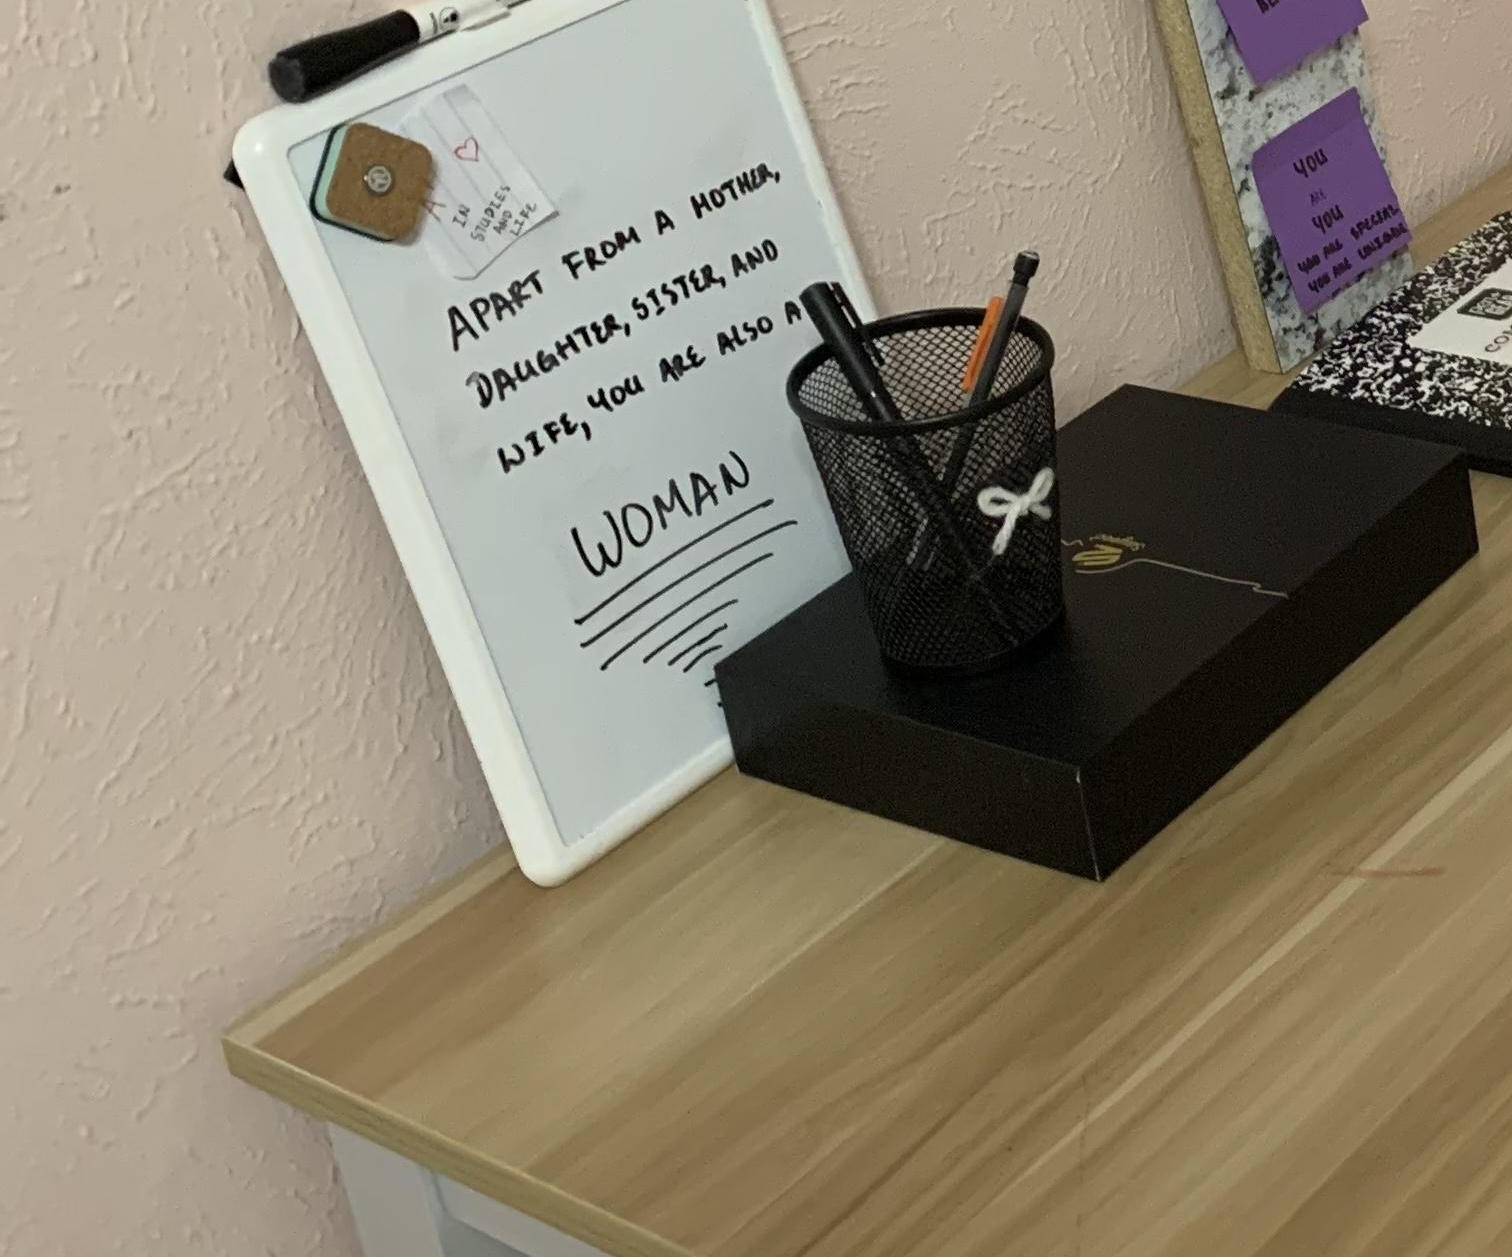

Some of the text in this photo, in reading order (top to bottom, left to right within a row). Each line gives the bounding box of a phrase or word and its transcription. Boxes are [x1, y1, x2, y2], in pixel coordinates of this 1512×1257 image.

[1293, 148, 1328, 178] YOU
[452, 203, 471, 228] IN
[470, 185, 511, 242] STUDIES
[493, 209, 513, 235] AND
[511, 203, 536, 234] LIFE
[1312, 204, 1344, 234] YOU
[447, 163, 781, 351] APART FROM A MOTHER,
[466, 238, 779, 409] DAUGHTER, SISTER, AND
[497, 300, 803, 474] WIFE, YOU ARE ALSO A
[571, 450, 750, 577] WOMAN
